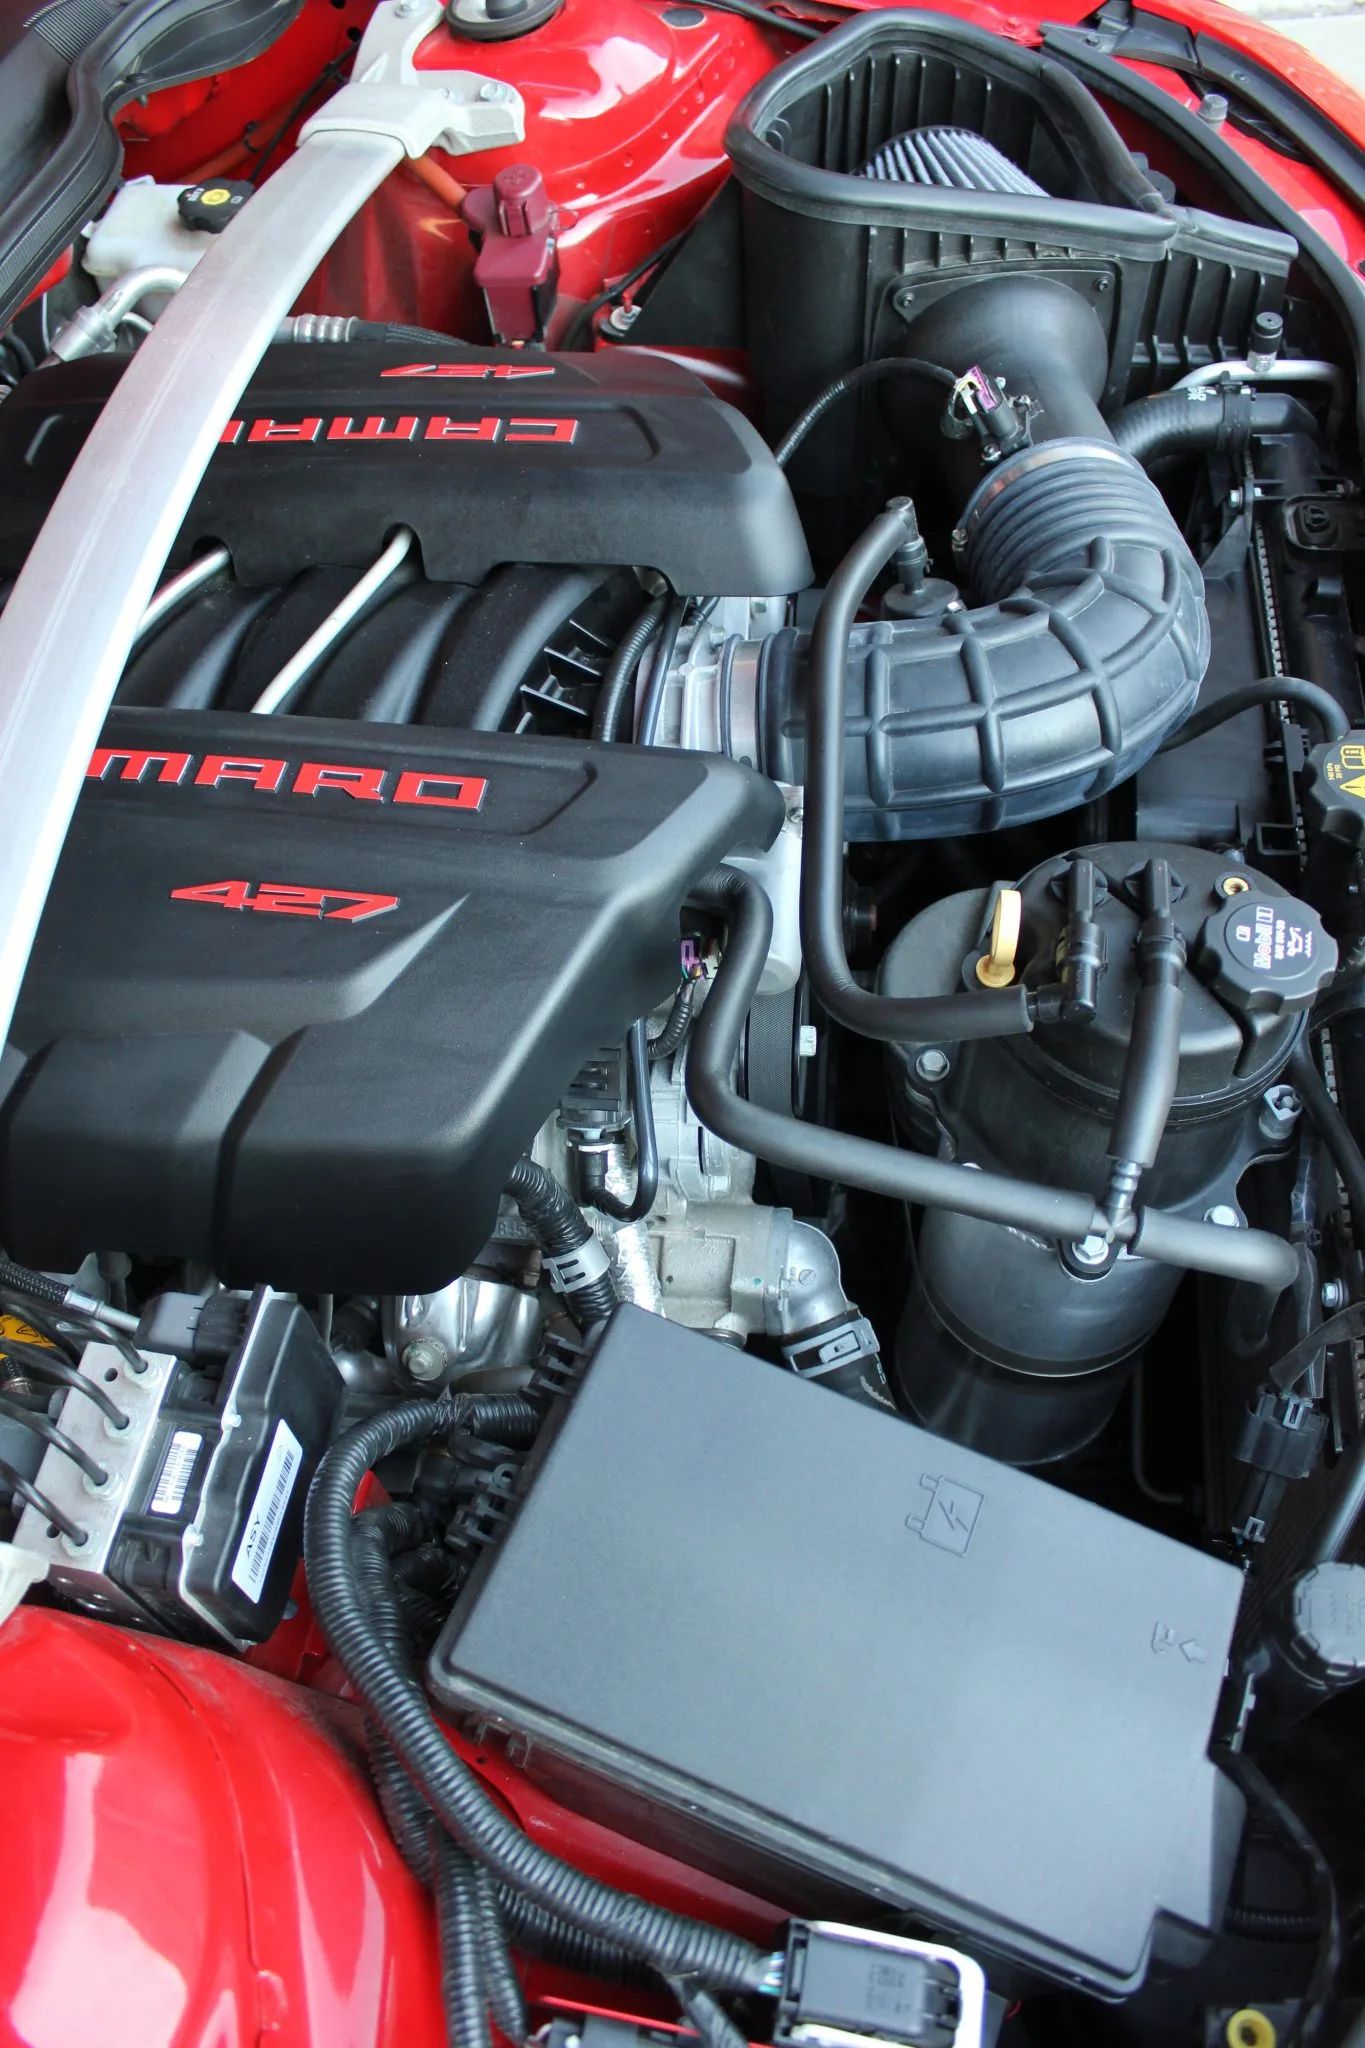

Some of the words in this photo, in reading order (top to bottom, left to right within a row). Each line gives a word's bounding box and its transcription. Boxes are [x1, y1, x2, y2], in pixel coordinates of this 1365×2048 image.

[379, 363, 556, 379] 427
[170, 879, 400, 923] 427
[1256, 906, 1274, 923] 1
[1253, 923, 1273, 969] Mobil
[246, 1512, 260, 1559] ASY
